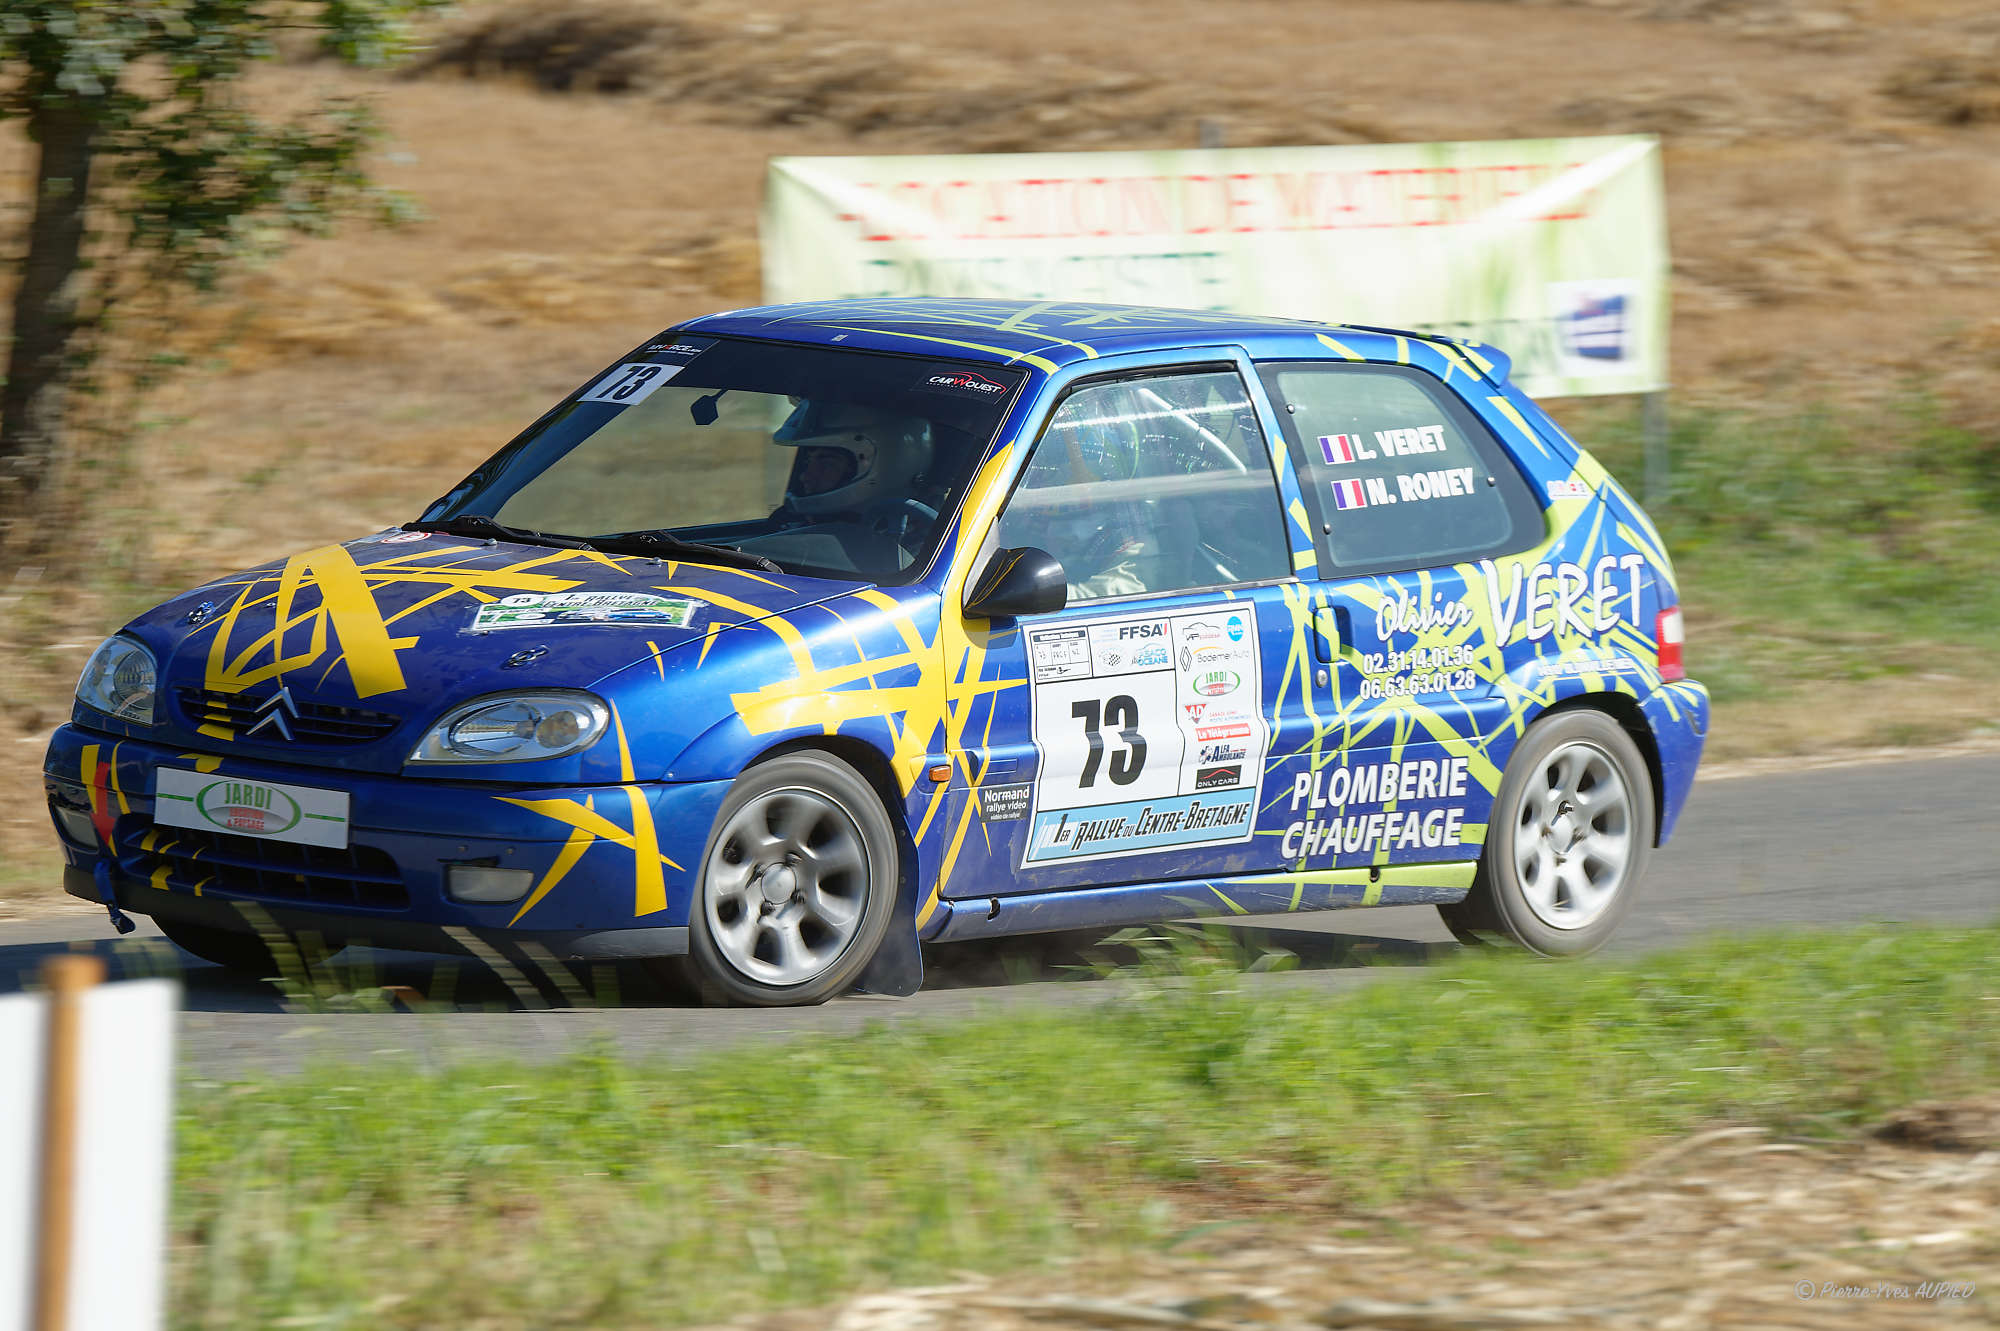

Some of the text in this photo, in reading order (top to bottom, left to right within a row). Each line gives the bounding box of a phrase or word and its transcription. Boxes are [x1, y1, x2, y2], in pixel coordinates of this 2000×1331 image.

[1183, 173, 1254, 234] DE
[595, 365, 662, 400] 73
[1353, 425, 1447, 461] L. VERET
[1368, 467, 1475, 506] N. RONEY
[1375, 553, 1646, 648] Olivier VERET
[1119, 623, 1163, 641] FFSA
[1363, 644, 1475, 675] 02.31.14.01.36
[1360, 670, 1476, 700] 06.63.63.01.28
[1071, 695, 1147, 788] 73
[225, 783, 272, 810] JARDI
[984, 785, 1030, 803] Normand
[1197, 777, 1238, 788] ONLY CARS
[1291, 756, 1468, 811] PLOMBERIE
[986, 803, 1006, 813] rallye
[1071, 818, 1127, 850] RALLYE
[1122, 825, 1134, 837] DU
[1134, 801, 1251, 837] CENTRE-BRETAGNE
[1280, 808, 1465, 860] CHAUFFAGE
